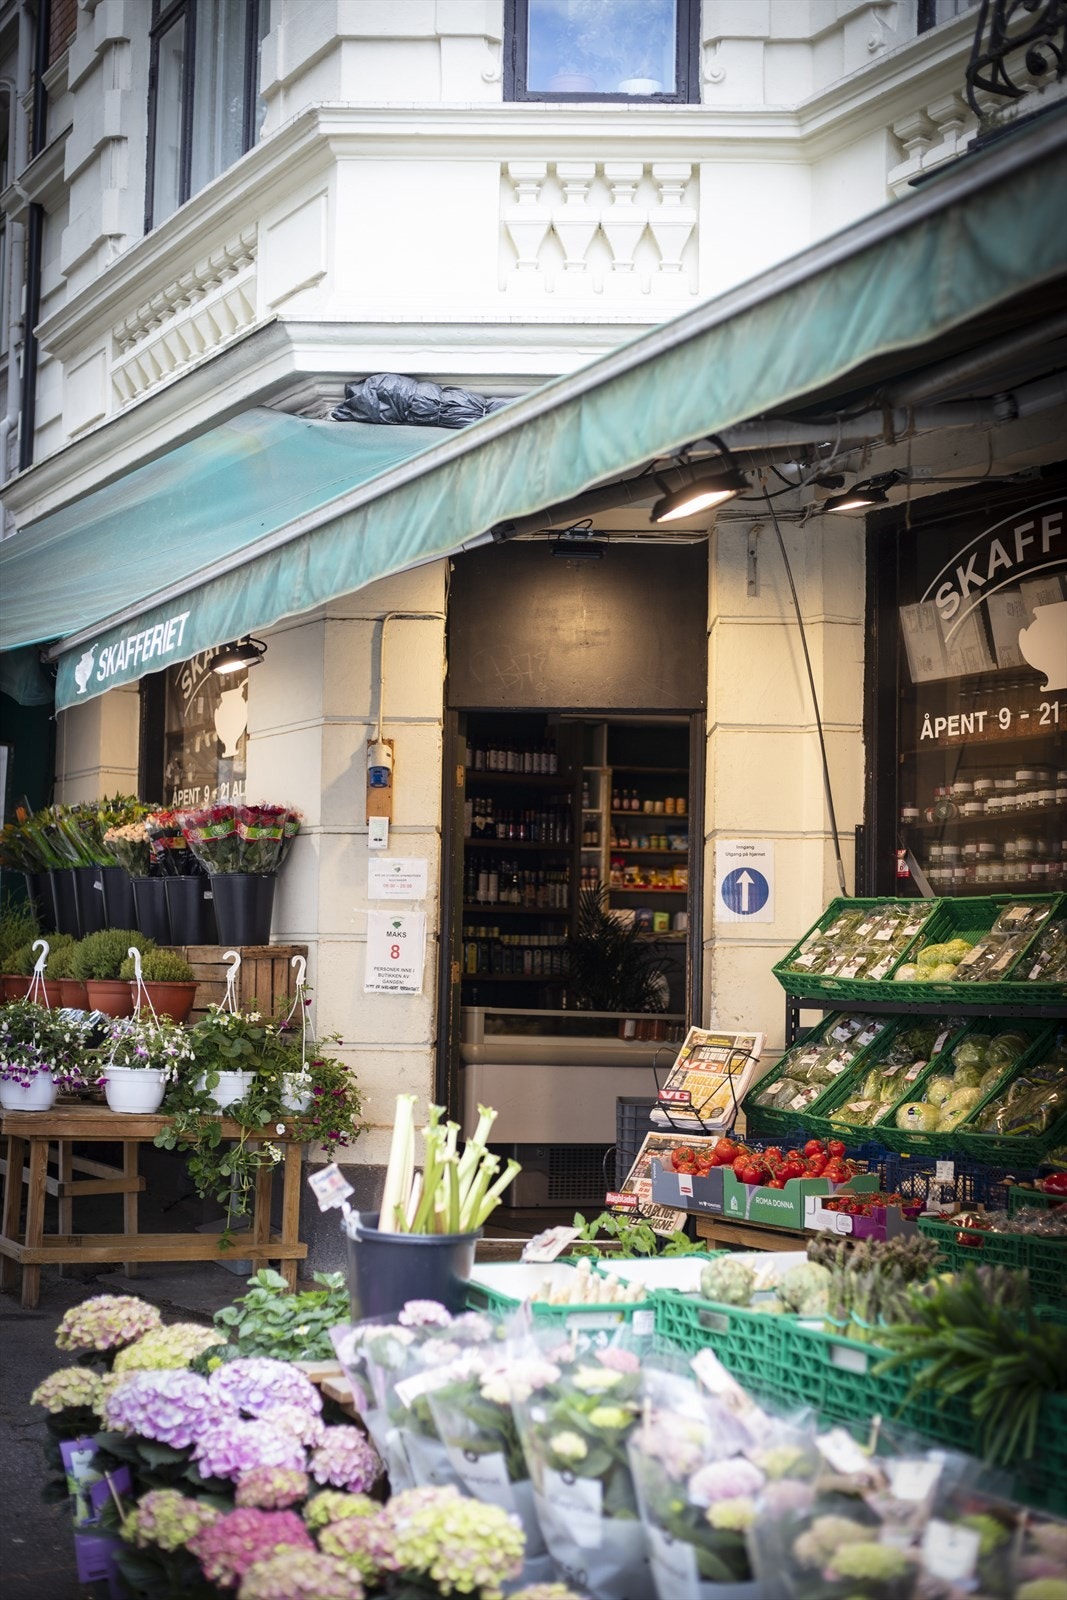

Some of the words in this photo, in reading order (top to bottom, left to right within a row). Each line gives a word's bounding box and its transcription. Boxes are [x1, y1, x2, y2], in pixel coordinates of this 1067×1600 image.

[936, 512, 1063, 620] SKAFF
[97, 611, 190, 682] SKAFFERIET
[920, 710, 988, 740] ÅPENT
[998, 707, 1011, 730] 9
[1039, 701, 1059, 726] 21
[172, 786, 200, 807] ÅPENT
[204, 785, 210, 802] 9
[220, 782, 230, 800] 21
[232, 780, 246, 797] AL
[390, 945, 400, 959] 8
[680, 1059, 718, 1071] VG
[659, 1090, 689, 1100] VG
[606, 1192, 637, 1204] Dagbladet
[756, 1196, 772, 1206] ROMA
[773, 1200, 794, 1210] DONNA
